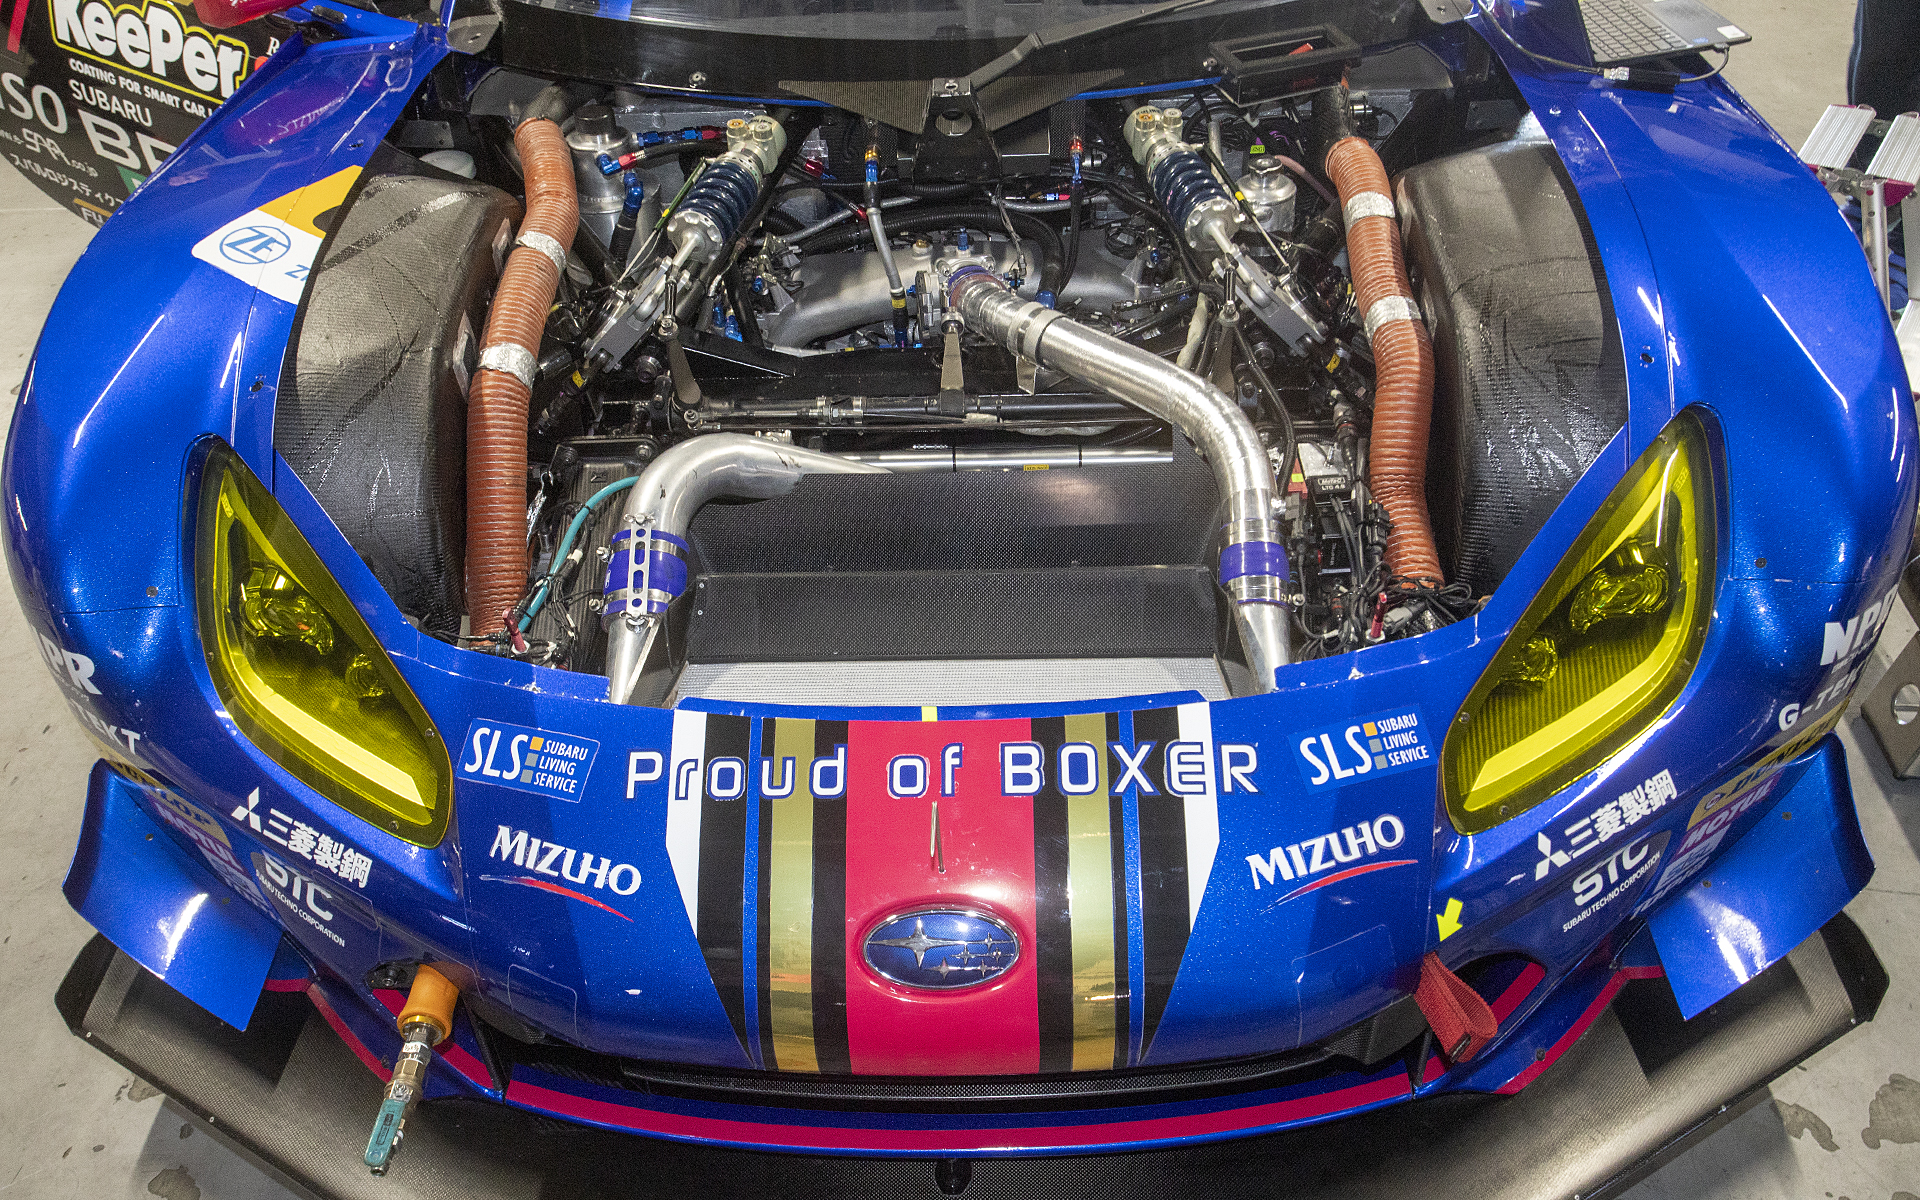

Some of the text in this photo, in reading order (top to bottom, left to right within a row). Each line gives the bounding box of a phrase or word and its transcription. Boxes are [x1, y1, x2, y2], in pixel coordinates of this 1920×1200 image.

[68, 78, 153, 127] SUBARU
[69, 57, 117, 86] COATING
[118, 75, 141, 96] FOR
[143, 85, 181, 109] SMART
[182, 100, 208, 118] CAR
[220, 226, 292, 265] ZF
[543, 739, 589, 761] SUBARU
[1377, 712, 1419, 734] SUBARU
[1382, 730, 1418, 751] LIVING
[464, 727, 529, 780] SLS
[538, 755, 577, 776] LIVING
[625, 741, 1259, 800] Proud of BOXER
[1299, 725, 1373, 785] SLS
[1387, 745, 1430, 767] SERVICE
[533, 772, 578, 794] SERVICE
[1564, 768, 1678, 860] 三菱製鋼
[262, 807, 374, 889] 三菱製鋼
[488, 824, 642, 896] MIZUHO
[1245, 814, 1405, 890] MIZUHO
[273, 886, 299, 914] TECHNO
[298, 908, 346, 948] CORPORATION
[1562, 908, 1592, 933] SUBARU
[1590, 887, 1620, 912] TECHNO
[1619, 850, 1661, 892] CORPORATION
